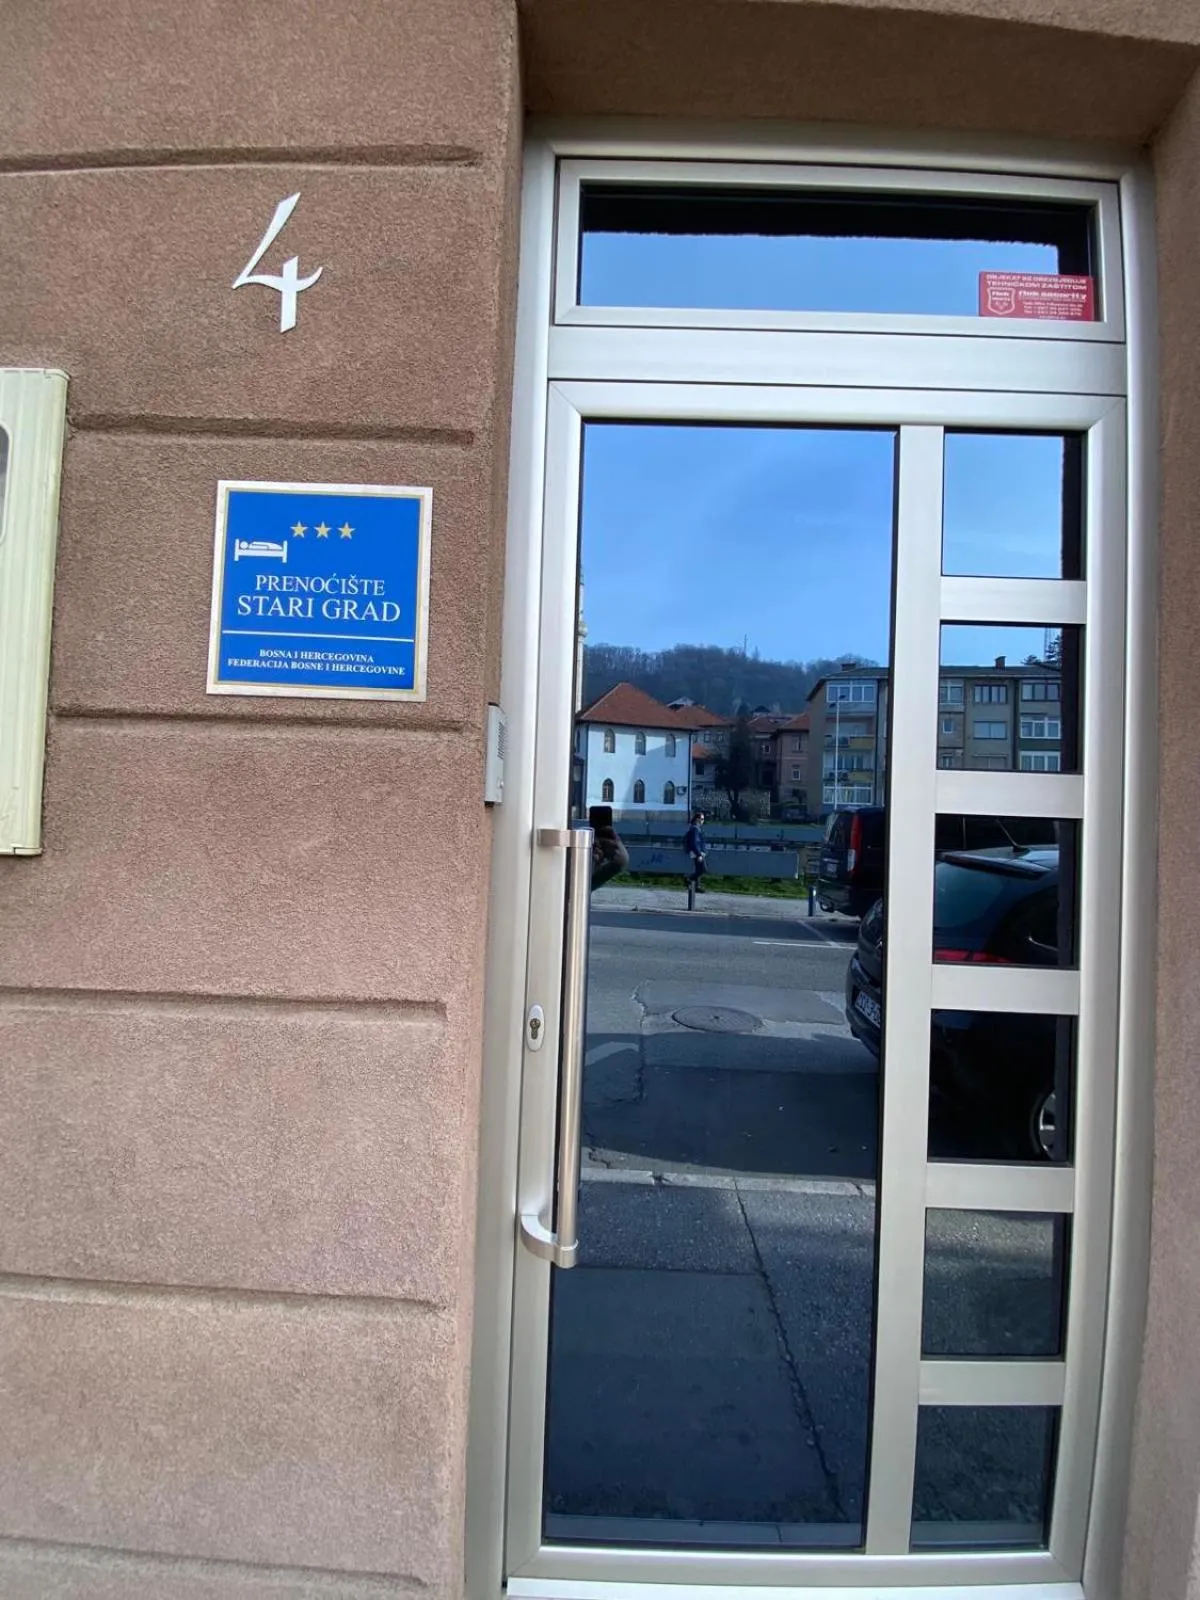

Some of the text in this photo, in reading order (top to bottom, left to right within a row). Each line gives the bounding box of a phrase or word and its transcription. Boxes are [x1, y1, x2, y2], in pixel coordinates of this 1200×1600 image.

[232, 192, 323, 333] 4
[255, 573, 385, 596] PRENOĆIŠTE
[237, 595, 401, 622] STARI GRAD
[227, 658, 406, 676] FEDERACIJA BOSNE I HERCEGOVINE
[259, 649, 374, 664] BOSNA I HERCEGOVINA
